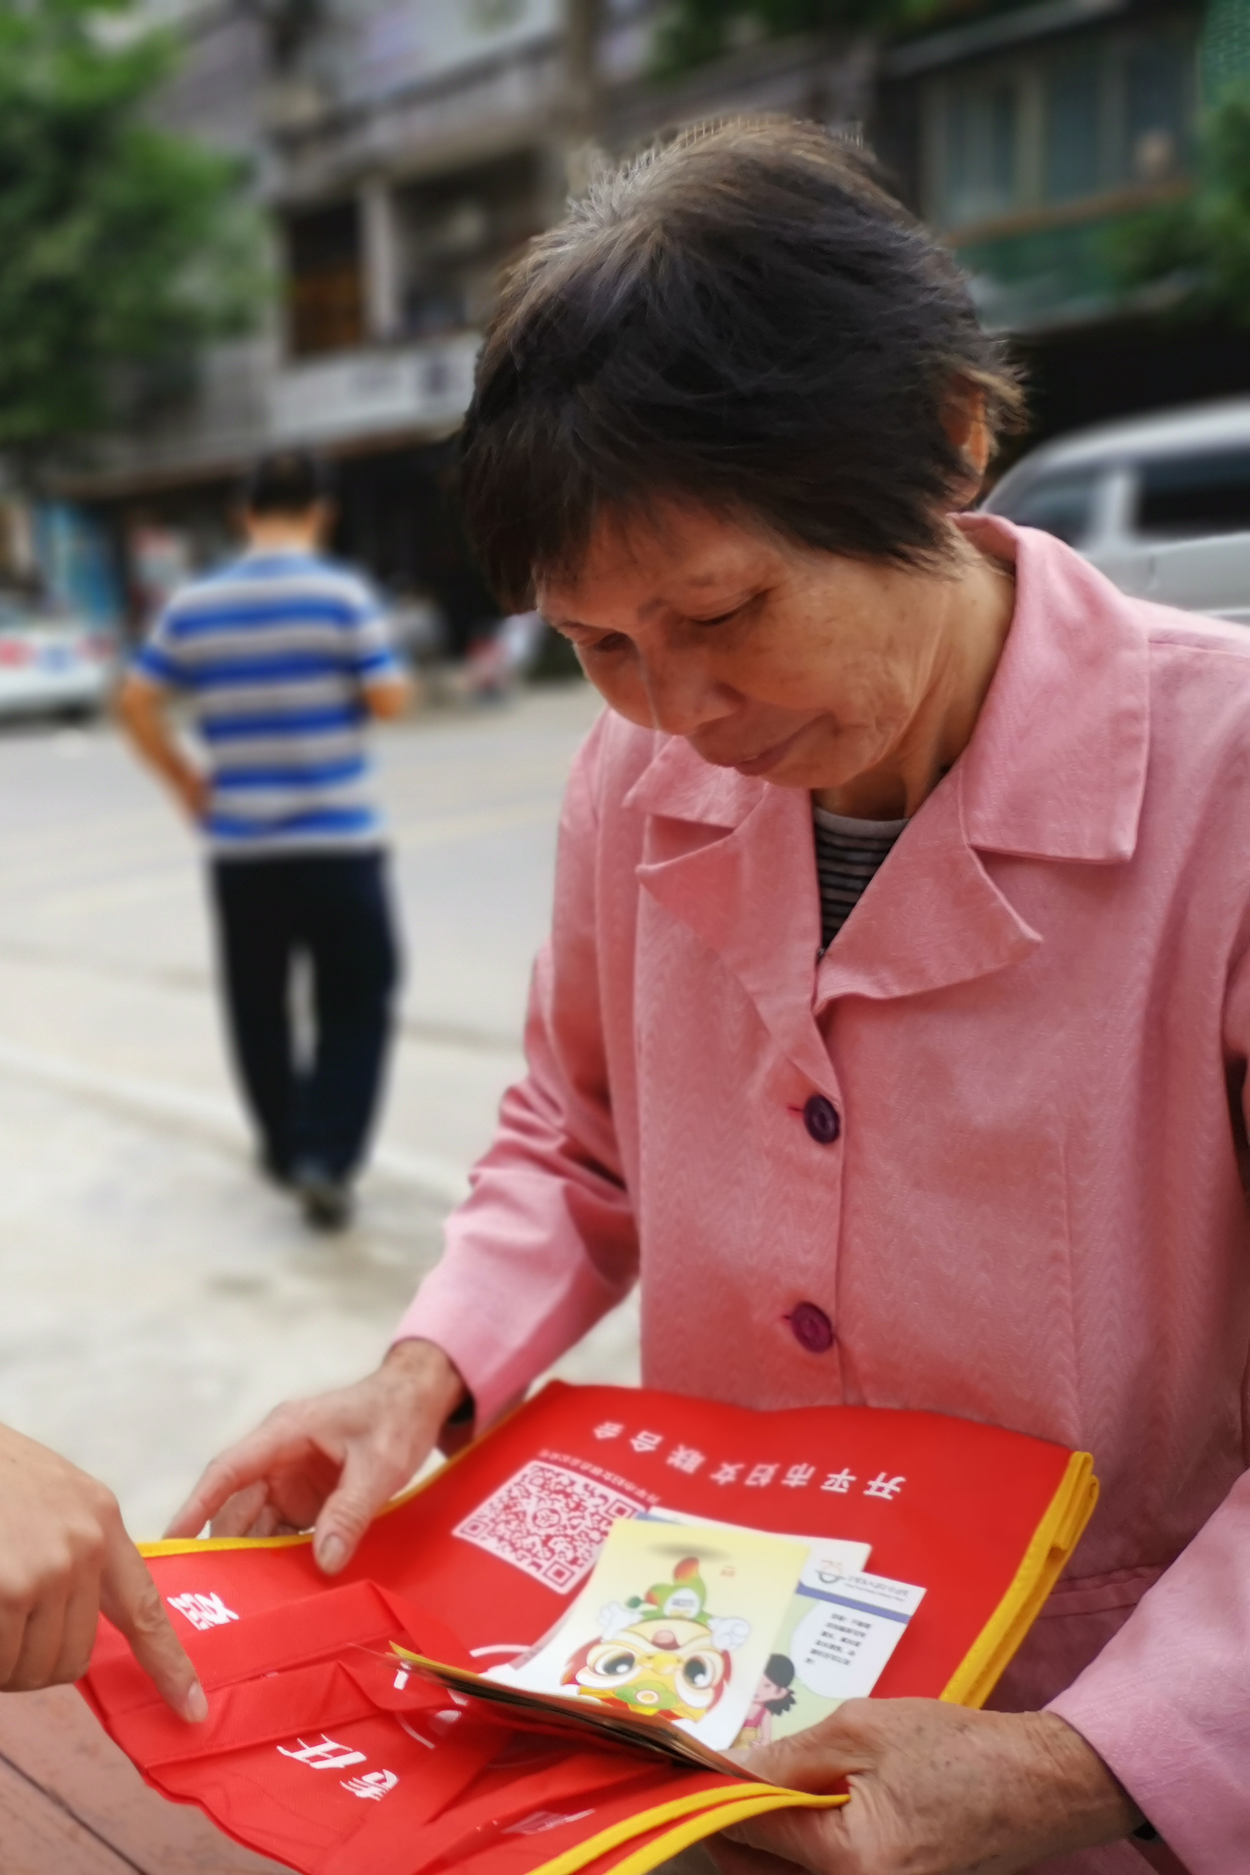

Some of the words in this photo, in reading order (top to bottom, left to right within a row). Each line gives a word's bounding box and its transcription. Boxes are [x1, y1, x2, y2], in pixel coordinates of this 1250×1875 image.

[592, 1421, 906, 1500] 开平市妇女联合会
